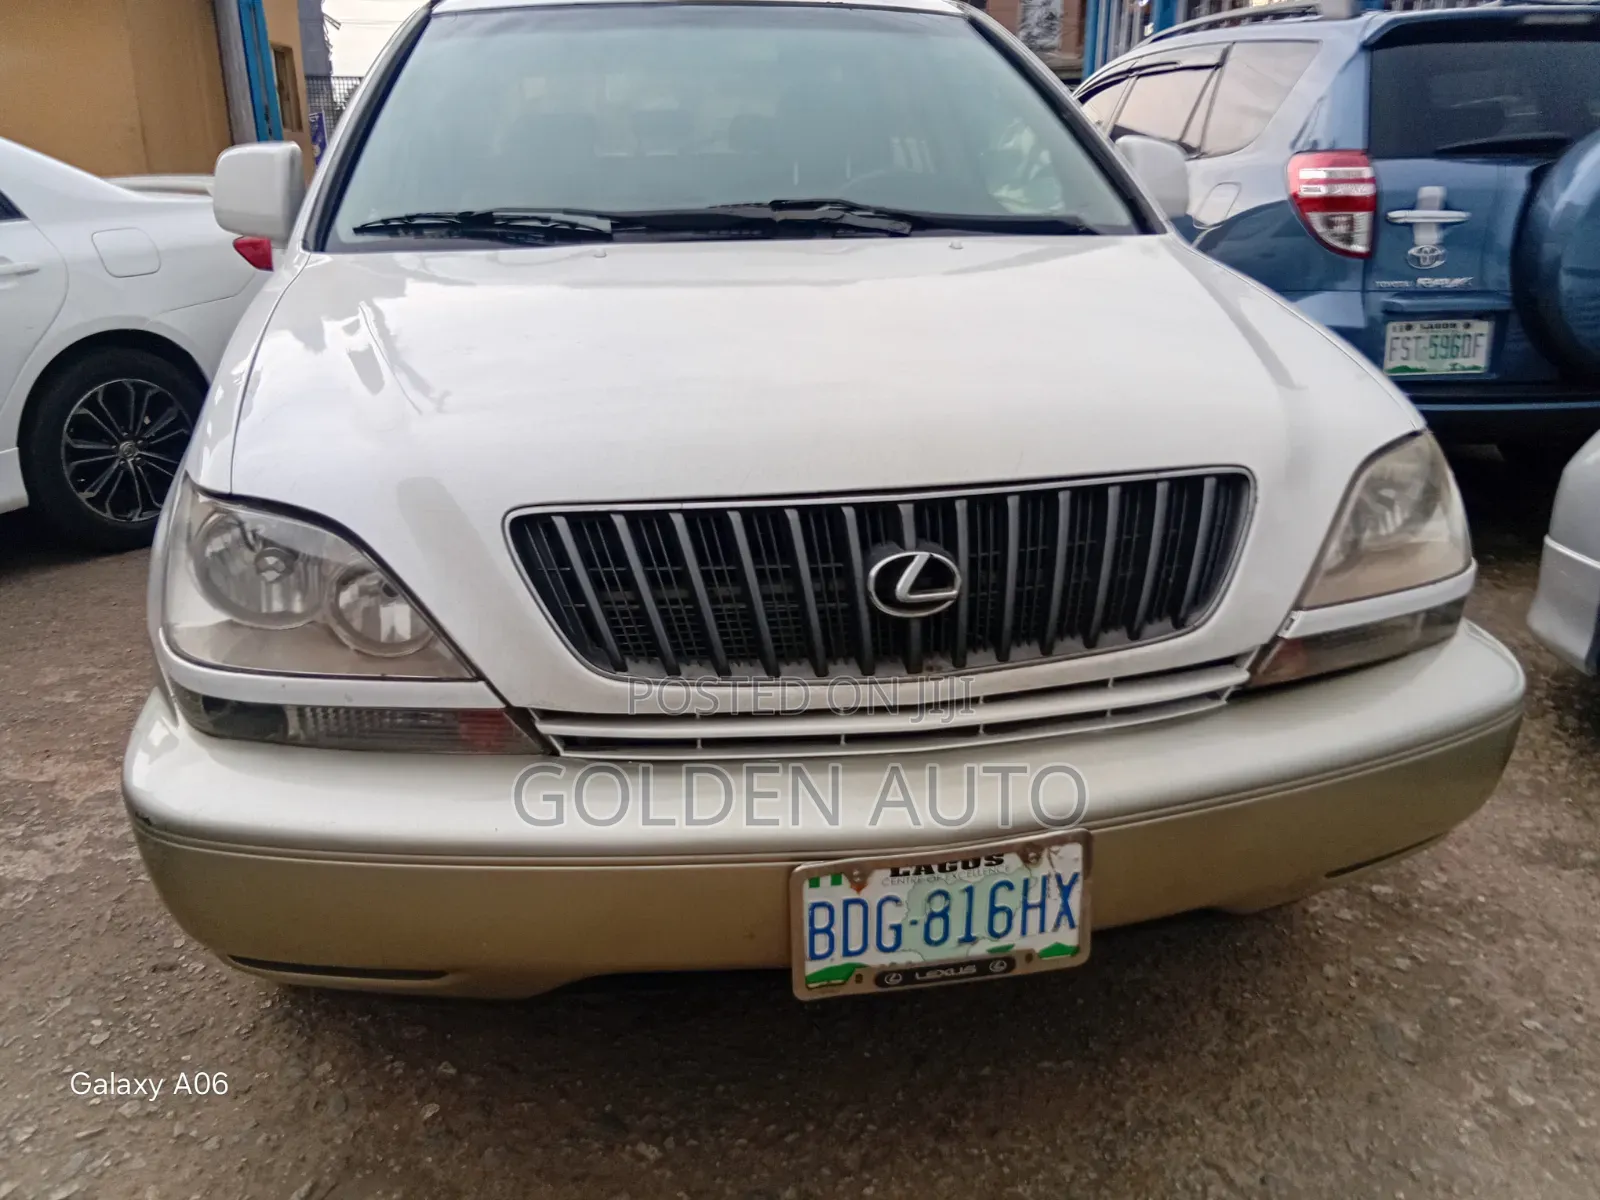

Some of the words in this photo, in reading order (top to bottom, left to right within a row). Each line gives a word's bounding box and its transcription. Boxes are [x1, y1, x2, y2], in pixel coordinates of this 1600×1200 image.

[890, 853, 1004, 877] LAGOS
[808, 872, 1080, 961] BDG-816HX
[915, 964, 977, 980] LEXUS
